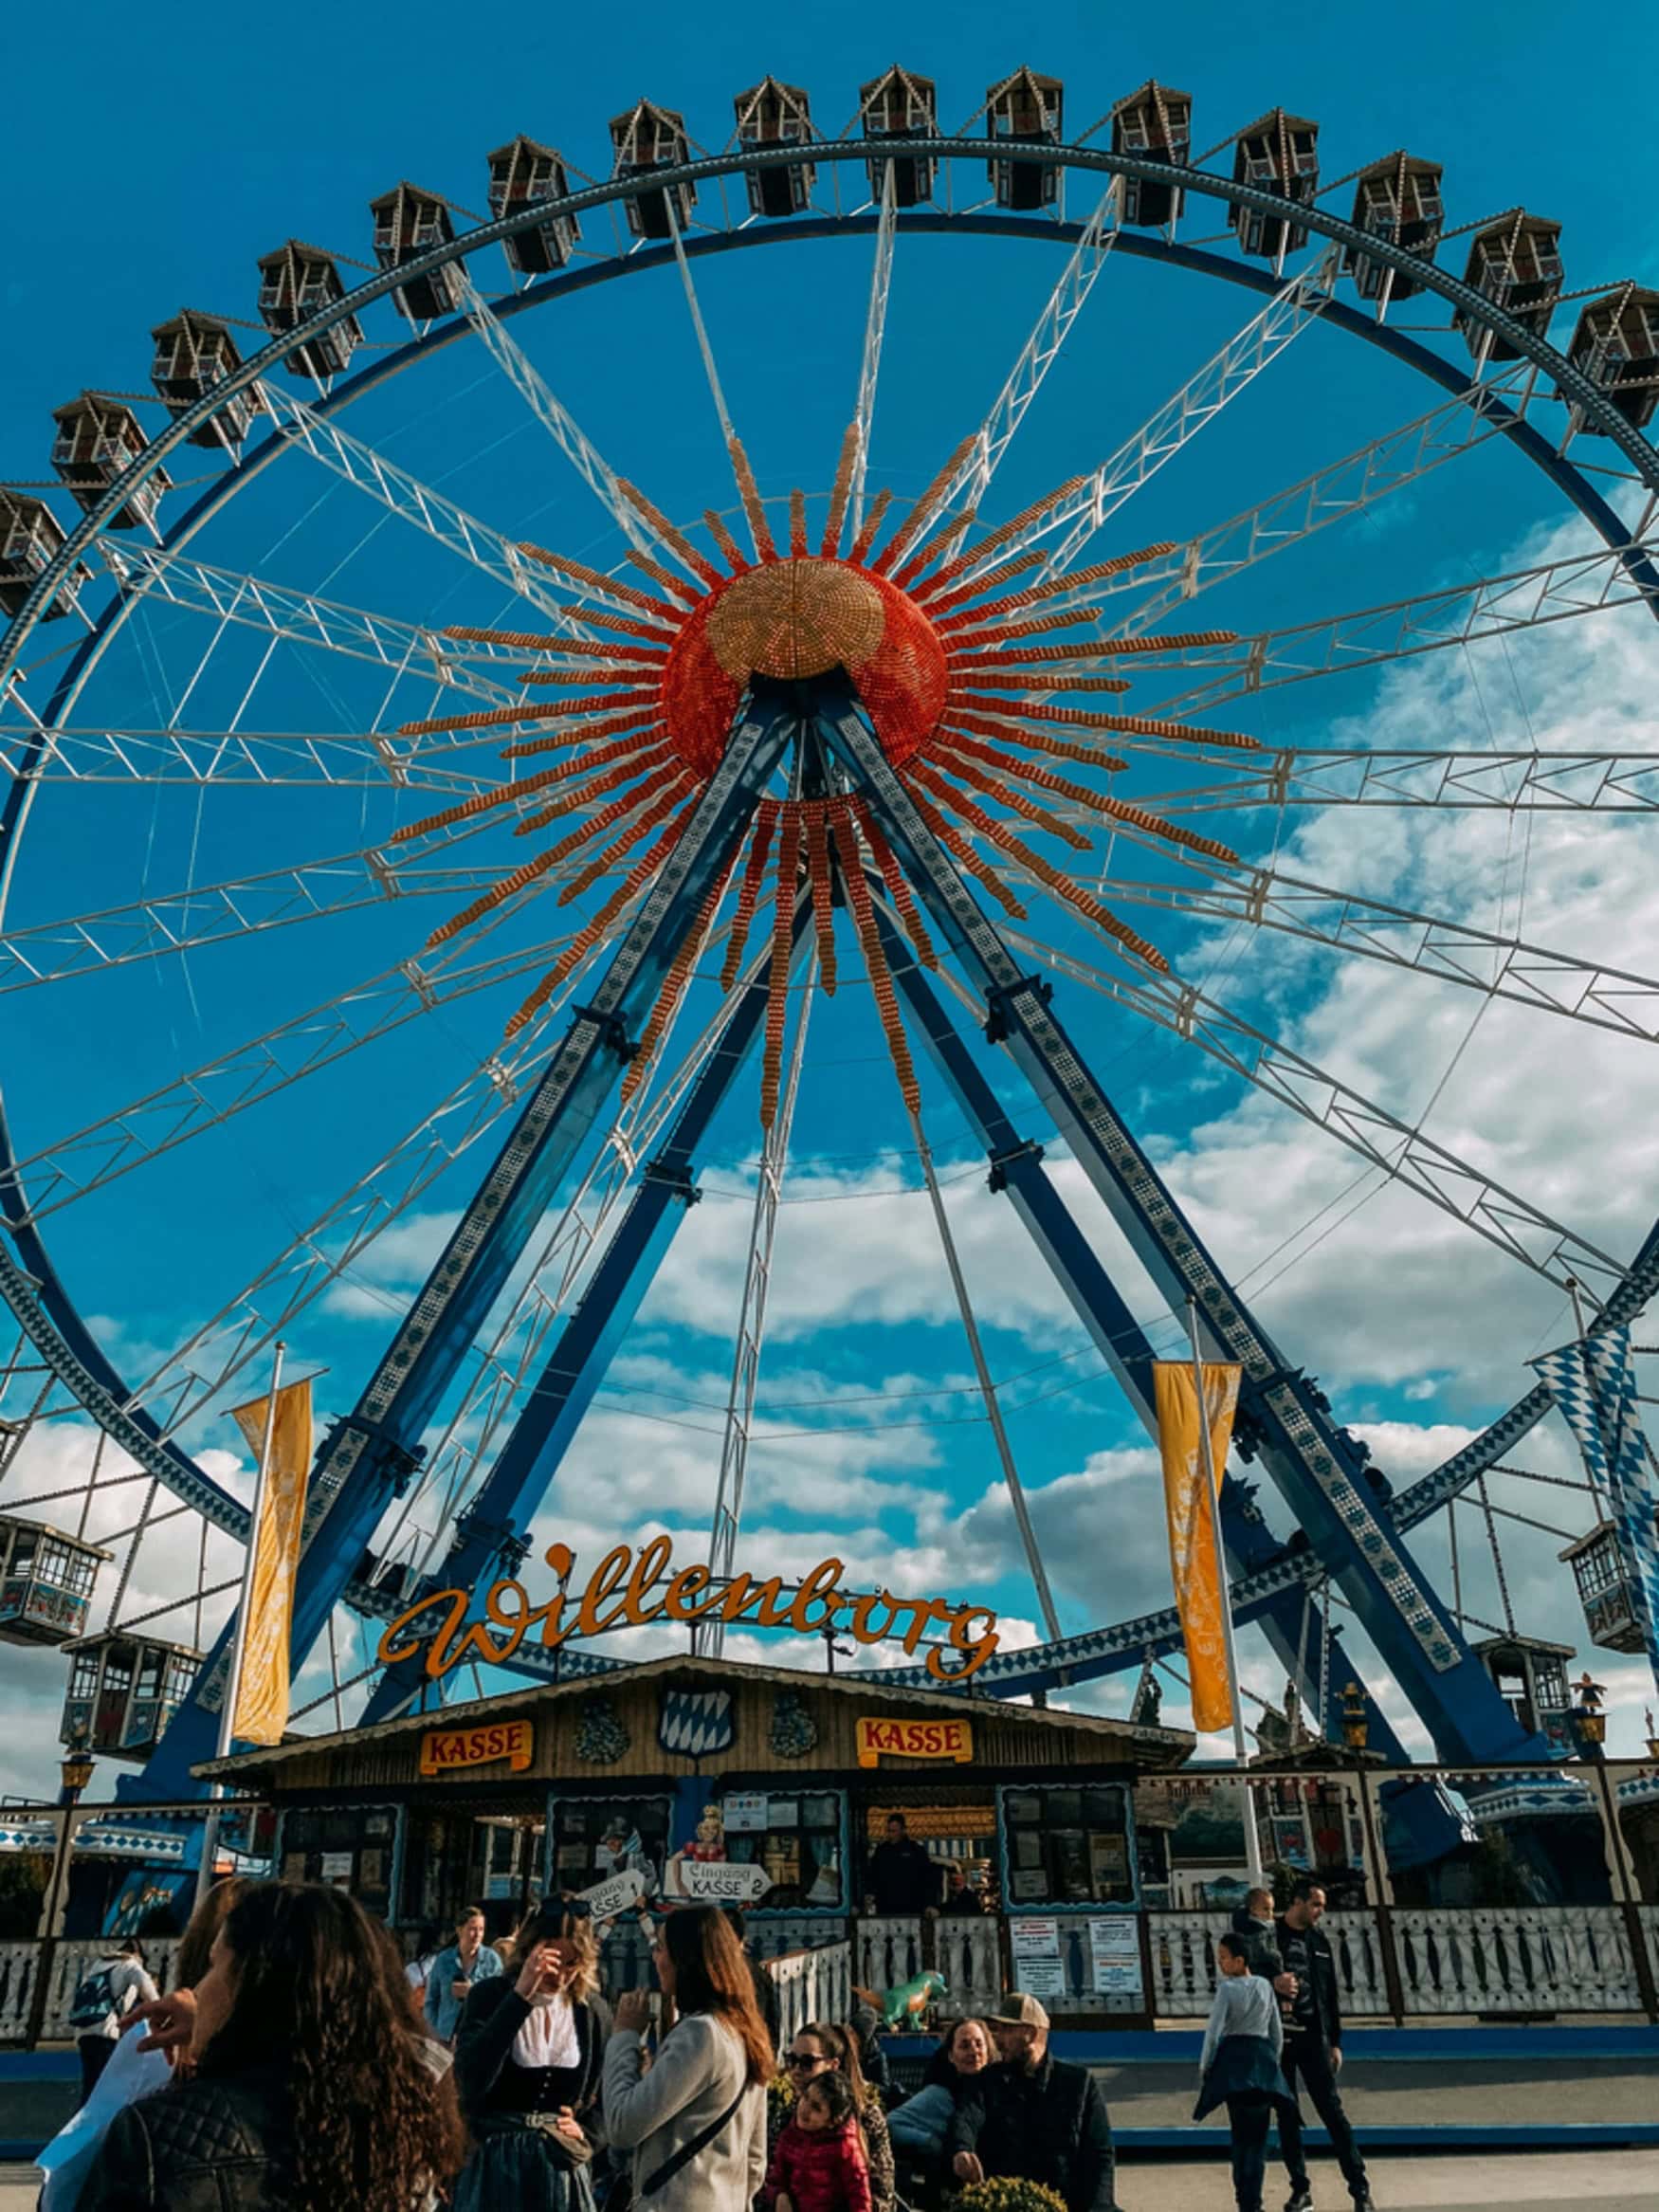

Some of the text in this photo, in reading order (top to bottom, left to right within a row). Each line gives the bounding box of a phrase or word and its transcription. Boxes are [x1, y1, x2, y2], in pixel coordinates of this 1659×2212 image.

[378, 1534, 1000, 1681] Willenborg
[429, 1724, 524, 1763] KASSE
[864, 1721, 962, 1753] KASSE
[692, 1879, 763, 1895] KASSE 2
[591, 1892, 623, 1917] SSE
